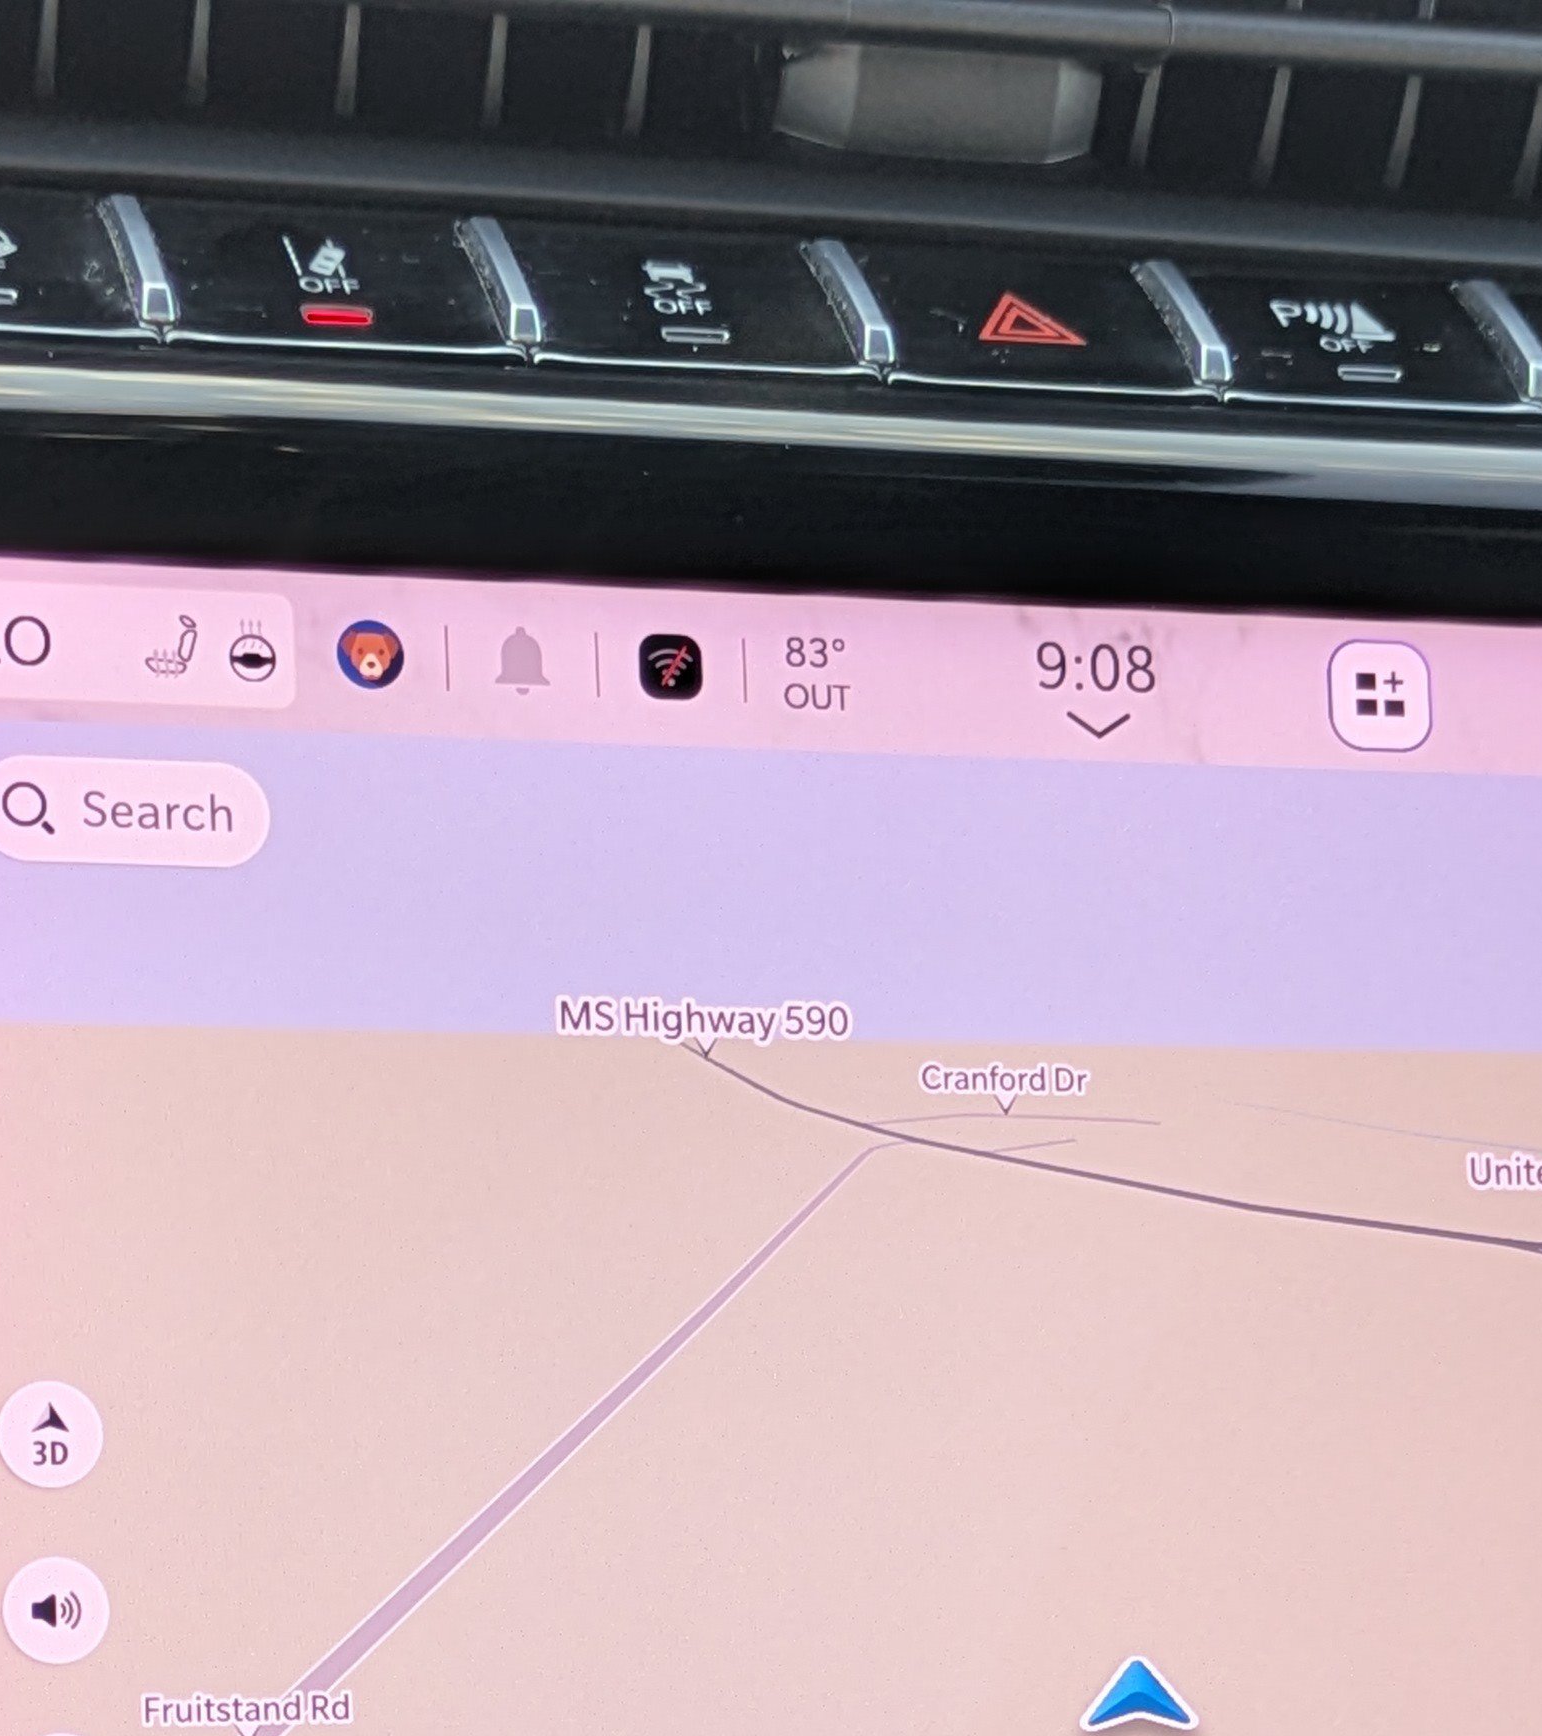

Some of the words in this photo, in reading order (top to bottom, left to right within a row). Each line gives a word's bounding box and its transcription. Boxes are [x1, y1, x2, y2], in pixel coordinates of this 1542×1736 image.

[299, 277, 359, 295] OFF
[653, 298, 712, 316] OFF
[1320, 336, 1373, 354] OFF
[784, 637, 846, 669] 83°
[1036, 641, 1156, 694] 9:08
[783, 683, 851, 712] OUT
[82, 790, 234, 834] Search
[560, 1001, 614, 1031] MS
[623, 1001, 776, 1040] Highway
[784, 1005, 850, 1036] 590
[922, 1064, 1045, 1093] Cranford
[1053, 1068, 1088, 1093] Dr
[33, 1441, 69, 1466] 3D
[144, 1696, 302, 1723] Fruitstand
[312, 1694, 351, 1721] Rd
